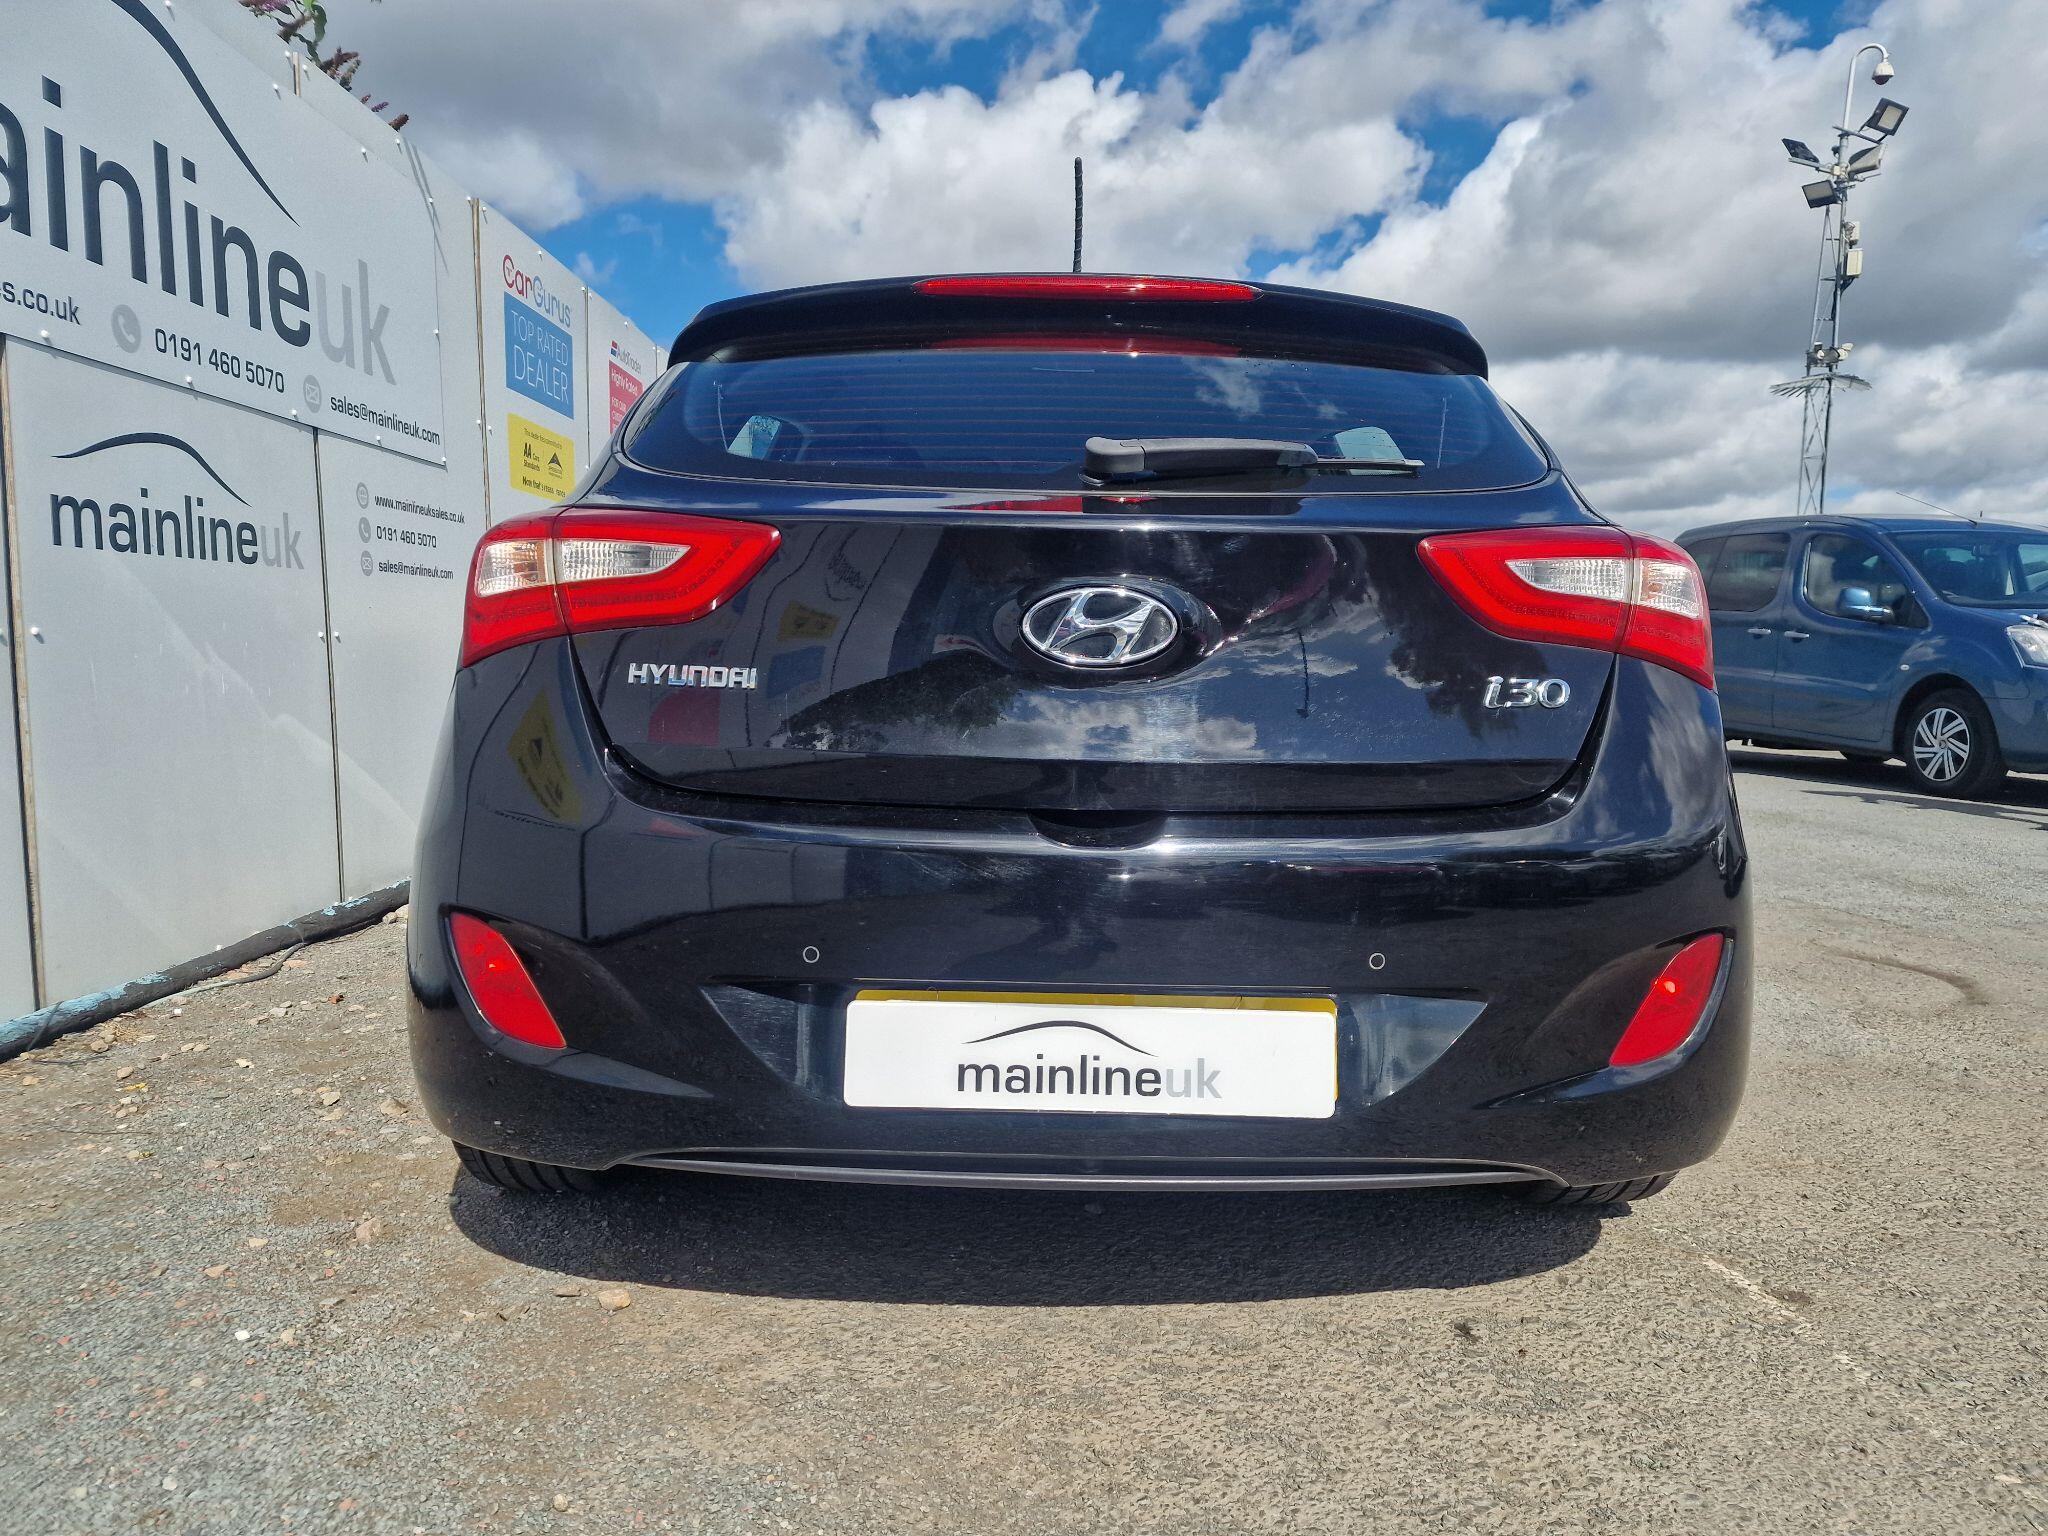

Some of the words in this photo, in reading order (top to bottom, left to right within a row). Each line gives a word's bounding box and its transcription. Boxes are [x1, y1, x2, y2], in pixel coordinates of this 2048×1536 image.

[0, 281, 81, 325] s.co.uk
[503, 255, 571, 328] CarGurus
[511, 310, 534, 344] TOP
[537, 327, 568, 366] RATED
[155, 328, 201, 365] 0191
[208, 348, 241, 378] 460
[245, 360, 285, 393] 5070
[514, 344, 569, 404] DEALER
[330, 396, 440, 446] sales@mainlineuk.com
[375, 495, 465, 524] www.mainlineuksales.co.uk
[376, 526, 397, 542] 0191
[400, 530, 416, 545] 460
[418, 533, 437, 548] 5070
[379, 560, 454, 580] sales@mainlineuk.com
[628, 663, 758, 690] HYUNDAI
[1483, 676, 1571, 708] i30
